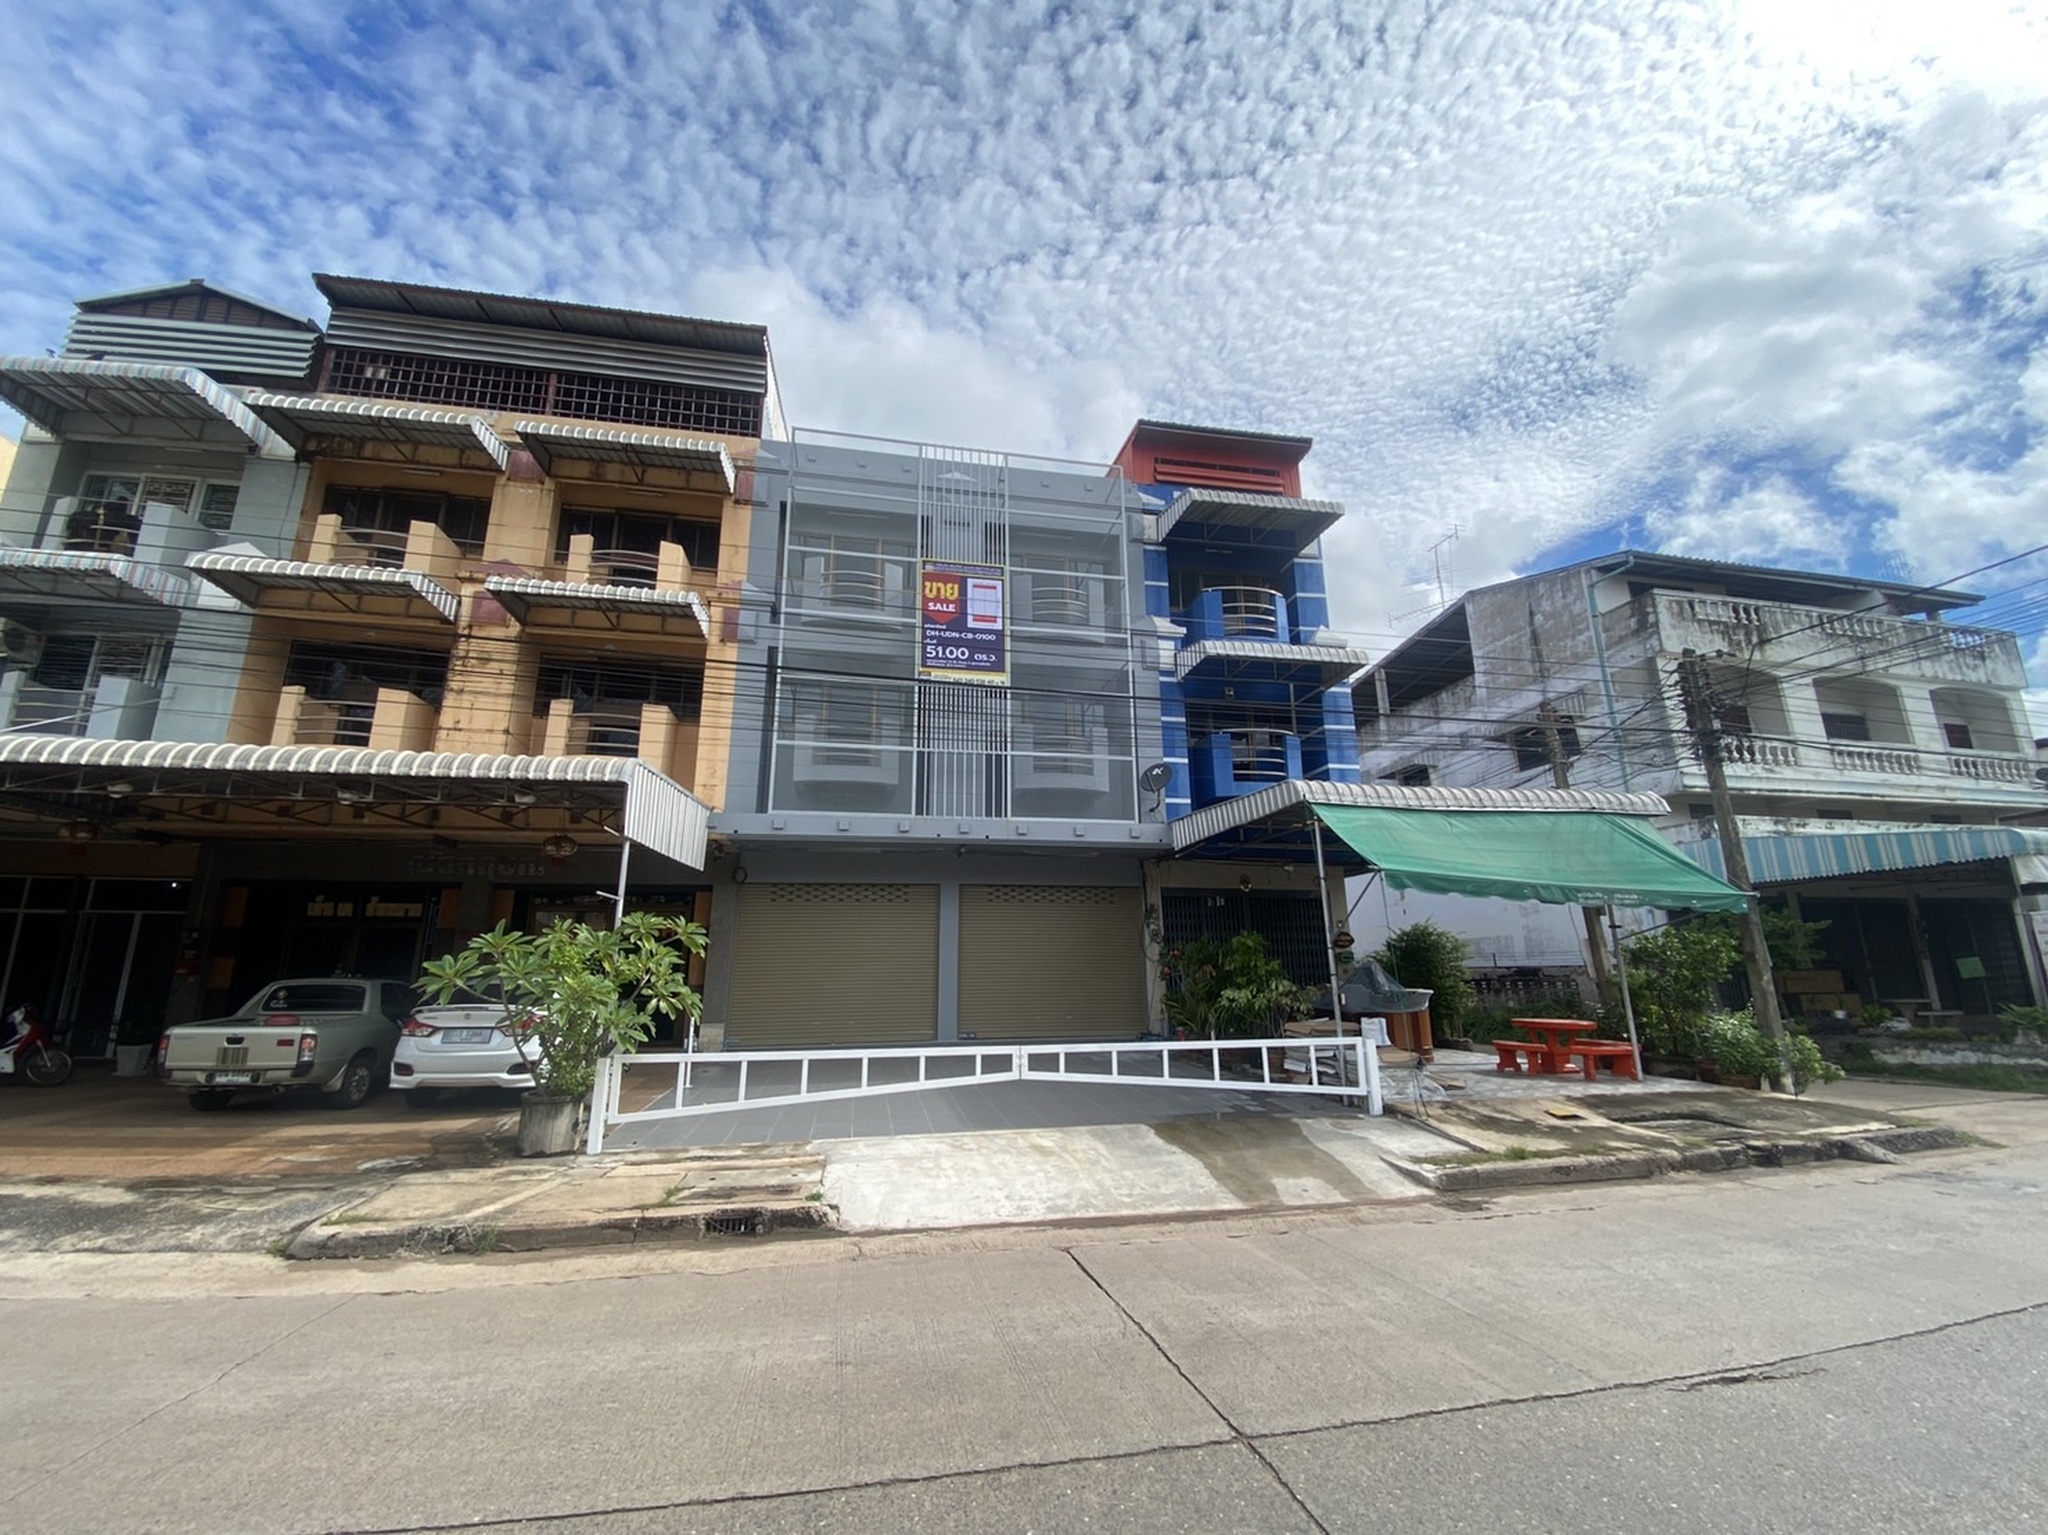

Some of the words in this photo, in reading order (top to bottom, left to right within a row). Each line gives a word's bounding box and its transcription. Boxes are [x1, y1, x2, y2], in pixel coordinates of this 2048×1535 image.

[924, 580, 959, 601] ขาย
[927, 602, 956, 612] SALE
[925, 645, 969, 660] 51.00
